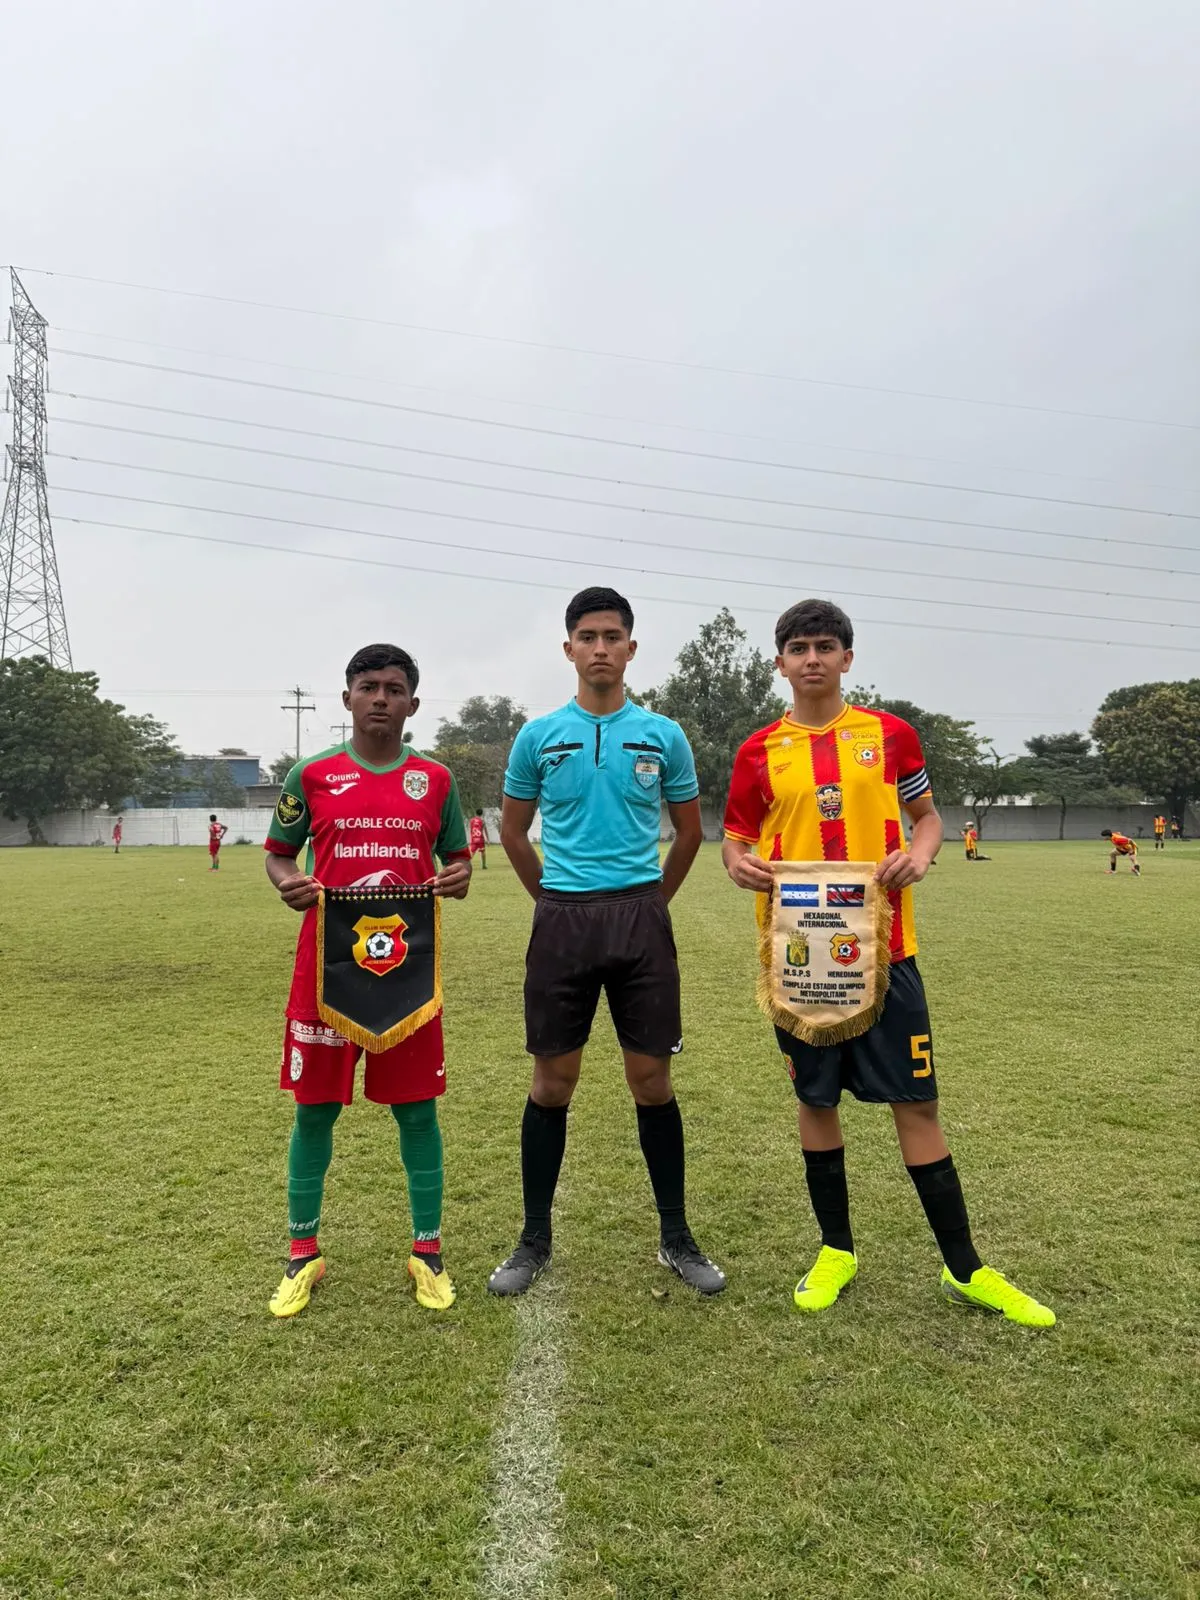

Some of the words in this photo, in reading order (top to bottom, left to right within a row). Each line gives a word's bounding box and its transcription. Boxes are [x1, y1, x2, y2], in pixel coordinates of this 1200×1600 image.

[346, 817, 383, 829] CABLE
[385, 817, 422, 831] COLOR
[334, 842, 420, 860] llantilandia
[803, 912, 842, 920] HEXAGONAL
[797, 920, 848, 929] INTERNACIONAL
[783, 968, 811, 978] M.S.P.S
[782, 980, 812, 989] COMPLEJO
[800, 990, 847, 998] METROPOLITANO
[316, 1026, 324, 1035] &
[910, 1034, 932, 1078] 5
